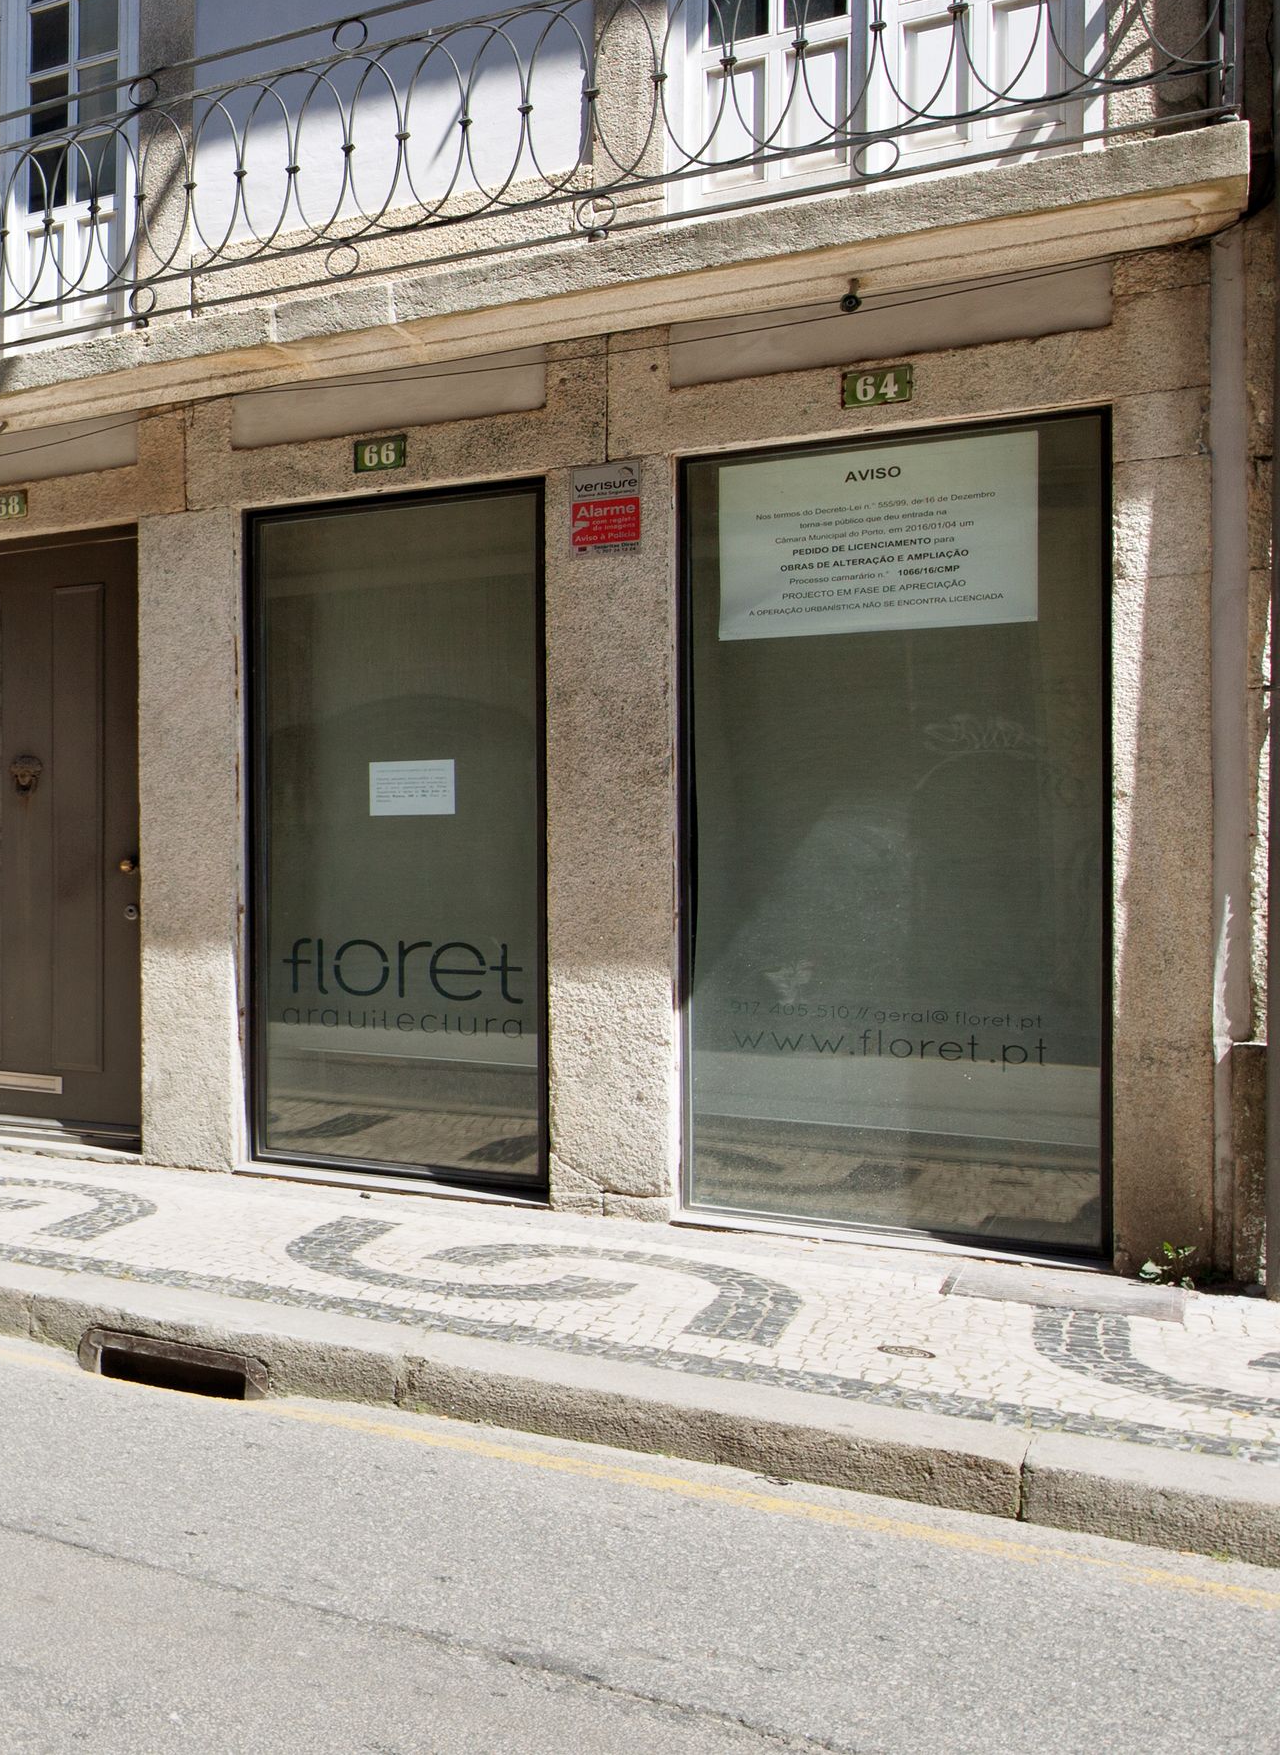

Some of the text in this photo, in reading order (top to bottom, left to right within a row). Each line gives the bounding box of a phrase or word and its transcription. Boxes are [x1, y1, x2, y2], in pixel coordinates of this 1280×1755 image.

[856, 373, 898, 401] 64
[364, 442, 396, 467] 66
[844, 465, 902, 483] AVISO
[575, 478, 638, 493] verisure
[577, 504, 636, 519] Alarme
[774, 511, 801, 519] termos
[815, 504, 862, 515] Decreto-Lei
[951, 491, 996, 501] Dezembro
[799, 520, 832, 529] torna-se
[835, 516, 864, 526] público
[866, 515, 881, 524] que
[883, 513, 900, 521] deu
[902, 510, 934, 519] entrada
[574, 533, 598, 542] Aviso
[607, 531, 636, 539] Polícia
[775, 535, 807, 545] Câmara
[808, 531, 847, 542] Municipal
[848, 529, 859, 537] do
[861, 528, 886, 537] Porto,
[905, 521, 957, 533] 2016/01/04
[959, 520, 975, 528] um
[792, 536, 955, 556] PEDIDO DE LICENCIAMENTO para
[780, 549, 970, 572] OBRAS DE ALTERAÇÃO E AMPLIAÇÃO
[789, 576, 829, 585] Processo
[831, 572, 876, 582] camarário
[897, 565, 960, 576] 1066/16/CMP
[782, 579, 967, 600] PROJECTO EM FASE DE APRECIAÇÃO
[756, 606, 803, 617] OPERAÇÃO
[804, 603, 861, 613] URBANÍSTICA
[862, 600, 881, 610] NÃO
[883, 599, 895, 607] SE
[897, 596, 947, 606] ENCONTRA
[948, 592, 1004, 603] LICENCIADA
[282, 937, 524, 1005] floret
[731, 1001, 760, 1015] 917
[768, 1003, 808, 1017] 405
[817, 1005, 850, 1019] 510
[282, 1007, 524, 1040] arquitectura
[733, 1029, 1047, 1073] www.floret.pt
